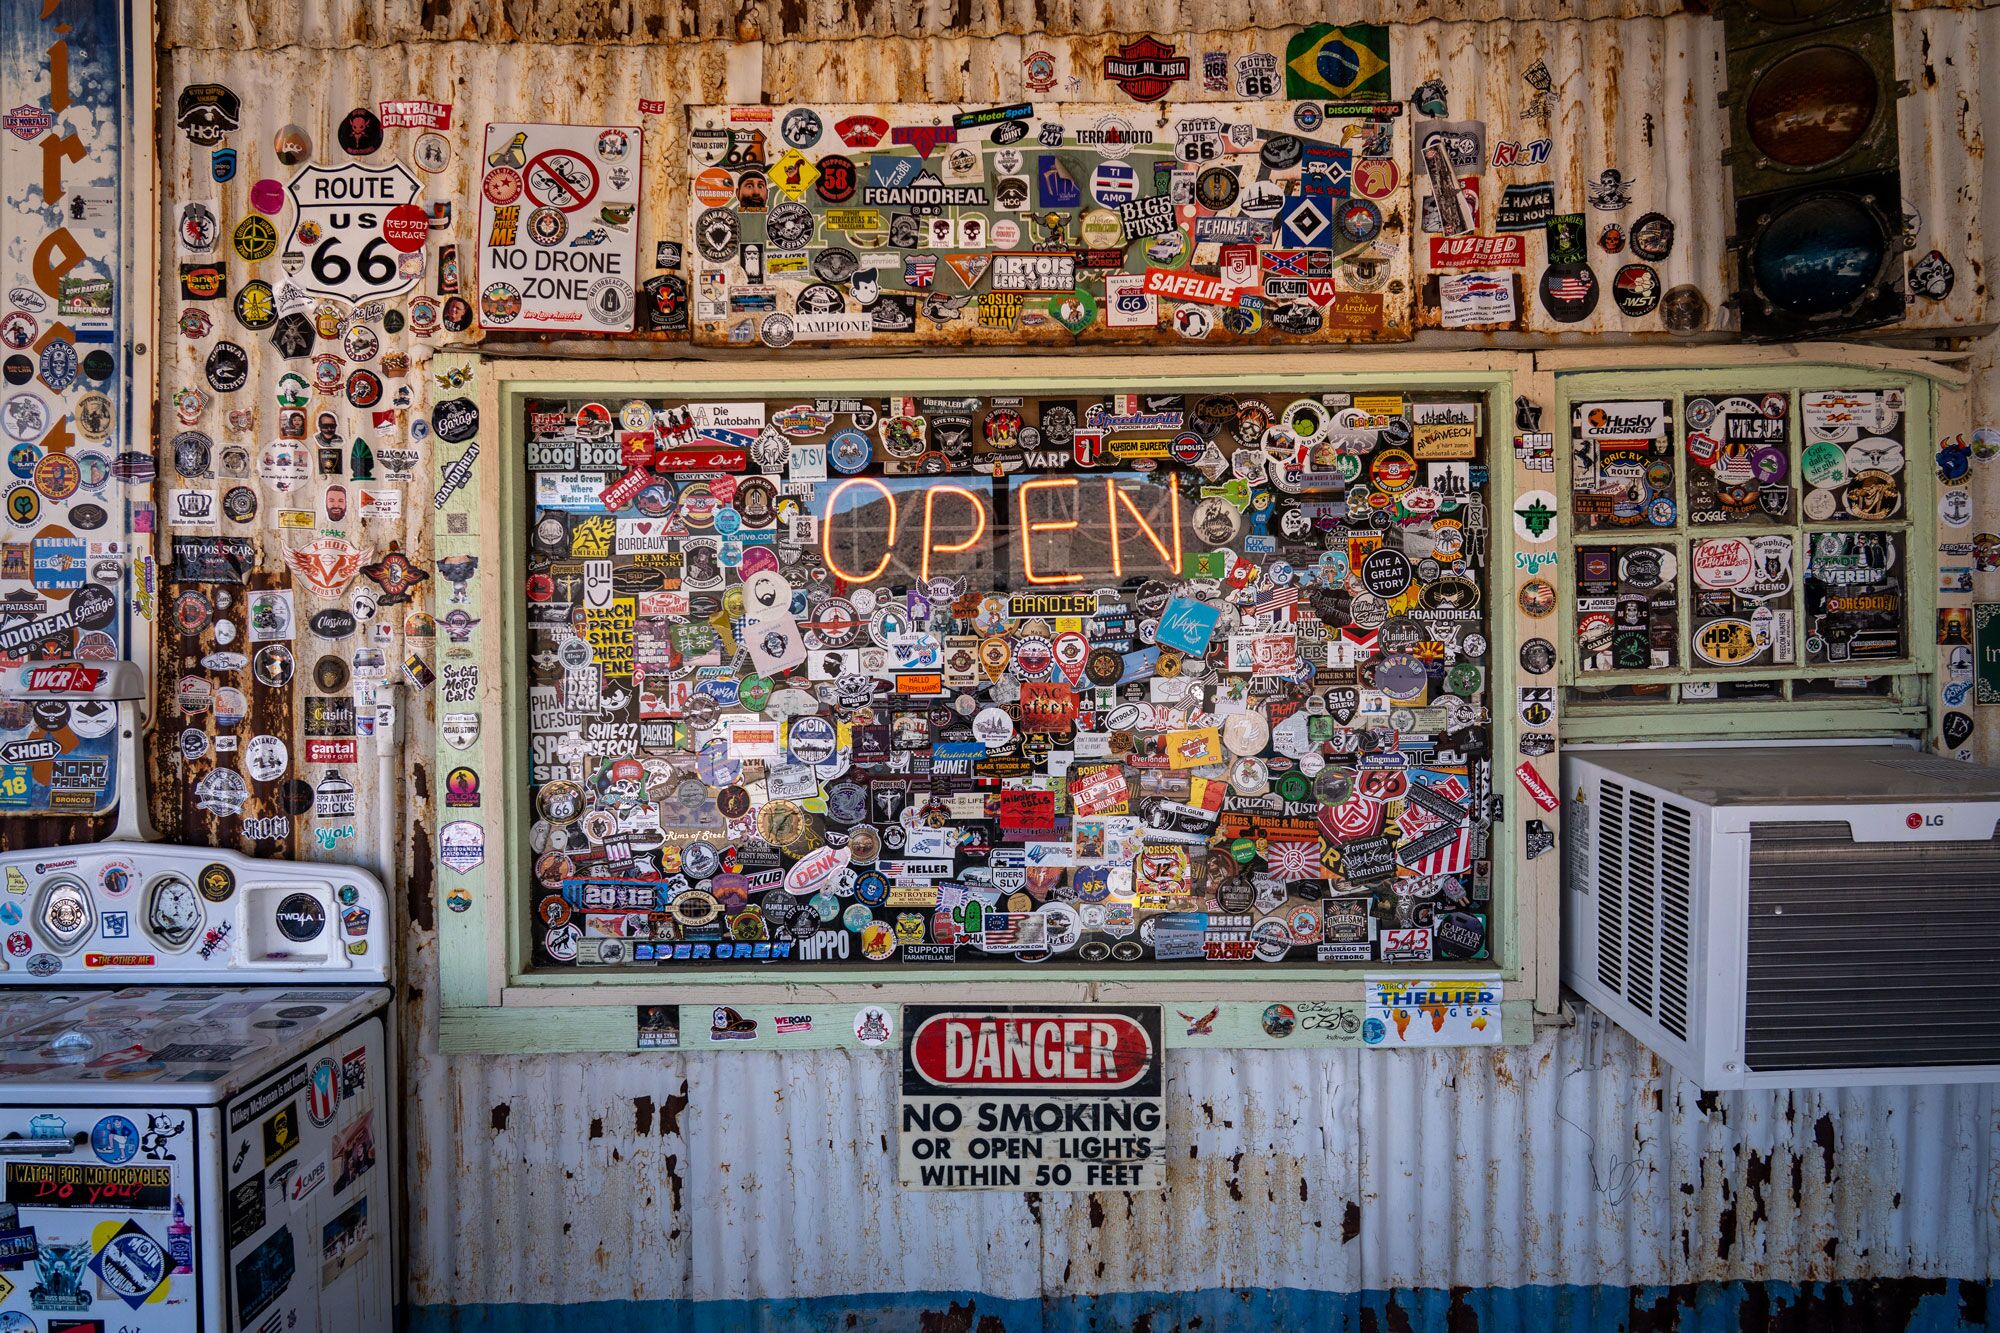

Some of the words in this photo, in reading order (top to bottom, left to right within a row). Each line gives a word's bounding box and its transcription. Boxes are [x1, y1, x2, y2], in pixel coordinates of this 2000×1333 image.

[1250, 69, 1263, 77] US
[1246, 77, 1272, 95] 66
[381, 102, 445, 117] FOOTBALL
[642, 102, 663, 112] SEE
[1328, 105, 1399, 115] DISCOVERMOTO
[977, 105, 1032, 123] MotorSport
[190, 124, 220, 138] HOG
[1181, 122, 1216, 132] ROUTE
[1041, 131, 1061, 144] 247
[1192, 134, 1206, 142] US
[727, 144, 757, 165] 66
[1185, 144, 1215, 160] 66
[824, 168, 846, 188] 58
[1110, 168, 1120, 176] TI
[315, 178, 394, 199] ROUTE
[697, 190, 733, 198] VAGABONDS
[865, 188, 988, 205] FGANDOREAL
[1102, 193, 1126, 203] AMO
[1514, 192, 1550, 208] HAVRE
[494, 206, 520, 221] THE
[1125, 212, 1175, 240] FUSSY
[389, 232, 426, 240] GARAGE
[491, 228, 517, 247] ME
[1438, 237, 1517, 254] AUZFEED
[311, 237, 396, 286] 66
[492, 249, 527, 270] NO
[535, 251, 621, 274] DRONE
[994, 258, 1074, 274] ARTOIS
[522, 277, 589, 300] ZONE
[994, 276, 1026, 289] LENS
[1041, 276, 1073, 289] BOYS
[1148, 272, 1234, 302] SAFELIFE
[1309, 282, 1334, 296] VA
[987, 294, 1015, 305] OSLO
[1122, 298, 1141, 309] 66
[1622, 296, 1656, 306] JWST
[796, 321, 871, 333] LAMPIONE
[1273, 315, 1290, 324] IRON
[1305, 315, 1320, 326] ART
[713, 407, 729, 416] Die
[438, 410, 478, 437] Garage
[713, 416, 761, 426] Autobahn
[1089, 412, 1182, 429] Speedworld
[1606, 415, 1657, 434] Husky
[528, 443, 576, 469] Boog
[801, 448, 824, 466] TSV
[1024, 451, 1070, 468] VARP
[1610, 468, 1641, 476] ROUTE
[561, 475, 579, 483] Food
[580, 475, 603, 483] Grows
[570, 484, 593, 493] Where
[605, 472, 643, 503] cantal
[560, 495, 581, 503] Water
[1692, 511, 1727, 522] GOGGLE
[822, 472, 1182, 585] OPEN
[36, 538, 86, 547] TRIBUNE
[618, 537, 665, 550] BORDEAUX
[1245, 536, 1265, 547] Cux
[1939, 543, 1973, 552] AEROMAC
[174, 544, 218, 555] TATTOOS
[634, 554, 648, 562] RE
[1370, 558, 1391, 568] LIVE
[1395, 557, 1401, 565] A
[1371, 568, 1403, 580] GREAT
[1826, 570, 1883, 584] VEREIN
[1372, 579, 1404, 590] STORY
[1012, 596, 1097, 613] BANDISM
[1408, 610, 1482, 620] FGANDOREAL
[1296, 625, 1328, 640] help
[1354, 650, 1370, 659] PERU
[33, 670, 72, 688] WCR
[443, 666, 460, 680] Sin
[461, 666, 478, 683] City
[568, 669, 599, 681] NUR
[909, 676, 929, 684] HALLO
[442, 678, 472, 692] Moto
[568, 681, 600, 695] DER
[899, 684, 940, 693] STOPPELMARKT
[1029, 687, 1062, 699] NAC
[1328, 691, 1354, 700] SLO
[567, 696, 598, 710] FCM
[1023, 700, 1068, 716] steer
[1329, 699, 1355, 709] BREW
[533, 712, 581, 730] LCF.SUB
[588, 723, 638, 739] SHIE47
[641, 725, 673, 745] PACKER
[9, 743, 53, 759] SHOEI
[311, 744, 354, 754] cantal
[798, 750, 827, 762] HAMBURG
[1132, 755, 1169, 763] Overlander
[1366, 755, 1400, 764] Kingman
[316, 793, 354, 803] SPRAYING
[317, 803, 355, 813] BRICKS
[555, 805, 570, 815] 66
[1175, 805, 1204, 817] BELGIUM
[1926, 815, 1943, 826] LG
[665, 830, 689, 841] Rims
[692, 830, 700, 839] of
[701, 830, 726, 839] Steel
[795, 850, 839, 886] DENK
[907, 865, 948, 874] HELLER
[999, 879, 1019, 888] SLV
[1387, 930, 1429, 945] 543
[1443, 922, 1482, 942] CAPTAIN
[801, 930, 849, 961] HIPPO
[1440, 930, 1480, 949] SCARLET
[907, 945, 949, 954] SUPPORT
[1203, 942, 1219, 951] JIM
[1221, 942, 1258, 951] KELLY
[99, 956, 111, 964] THE
[113, 956, 137, 964] OTHER
[139, 956, 151, 964] ME
[1207, 949, 1254, 959] RACING
[1378, 992, 1494, 1005] THELLIER
[1383, 1007, 1488, 1019] VOYAGES
[774, 1015, 812, 1025] WEROAD
[945, 1021, 1119, 1079] DANGER
[903, 1103, 963, 1133] NO
[978, 1102, 1161, 1133] SMOKING
[911, 1138, 952, 1160] OR
[968, 1138, 1044, 1160] OPEN
[1058, 1137, 1152, 1160] LIGHTS
[8, 1166, 12, 1182] I
[16, 1165, 54, 1182] WATCH
[59, 1166, 81, 1184] FOR
[86, 1167, 170, 1186] MOTORCYCLES
[921, 1165, 1021, 1187] WITHIN
[1035, 1164, 1071, 1187] 50
[1087, 1164, 1144, 1186] FEET
[35, 1180, 74, 1198] Do
[89, 1181, 144, 1204] you?
[105, 1262, 137, 1293] HAMBURG
